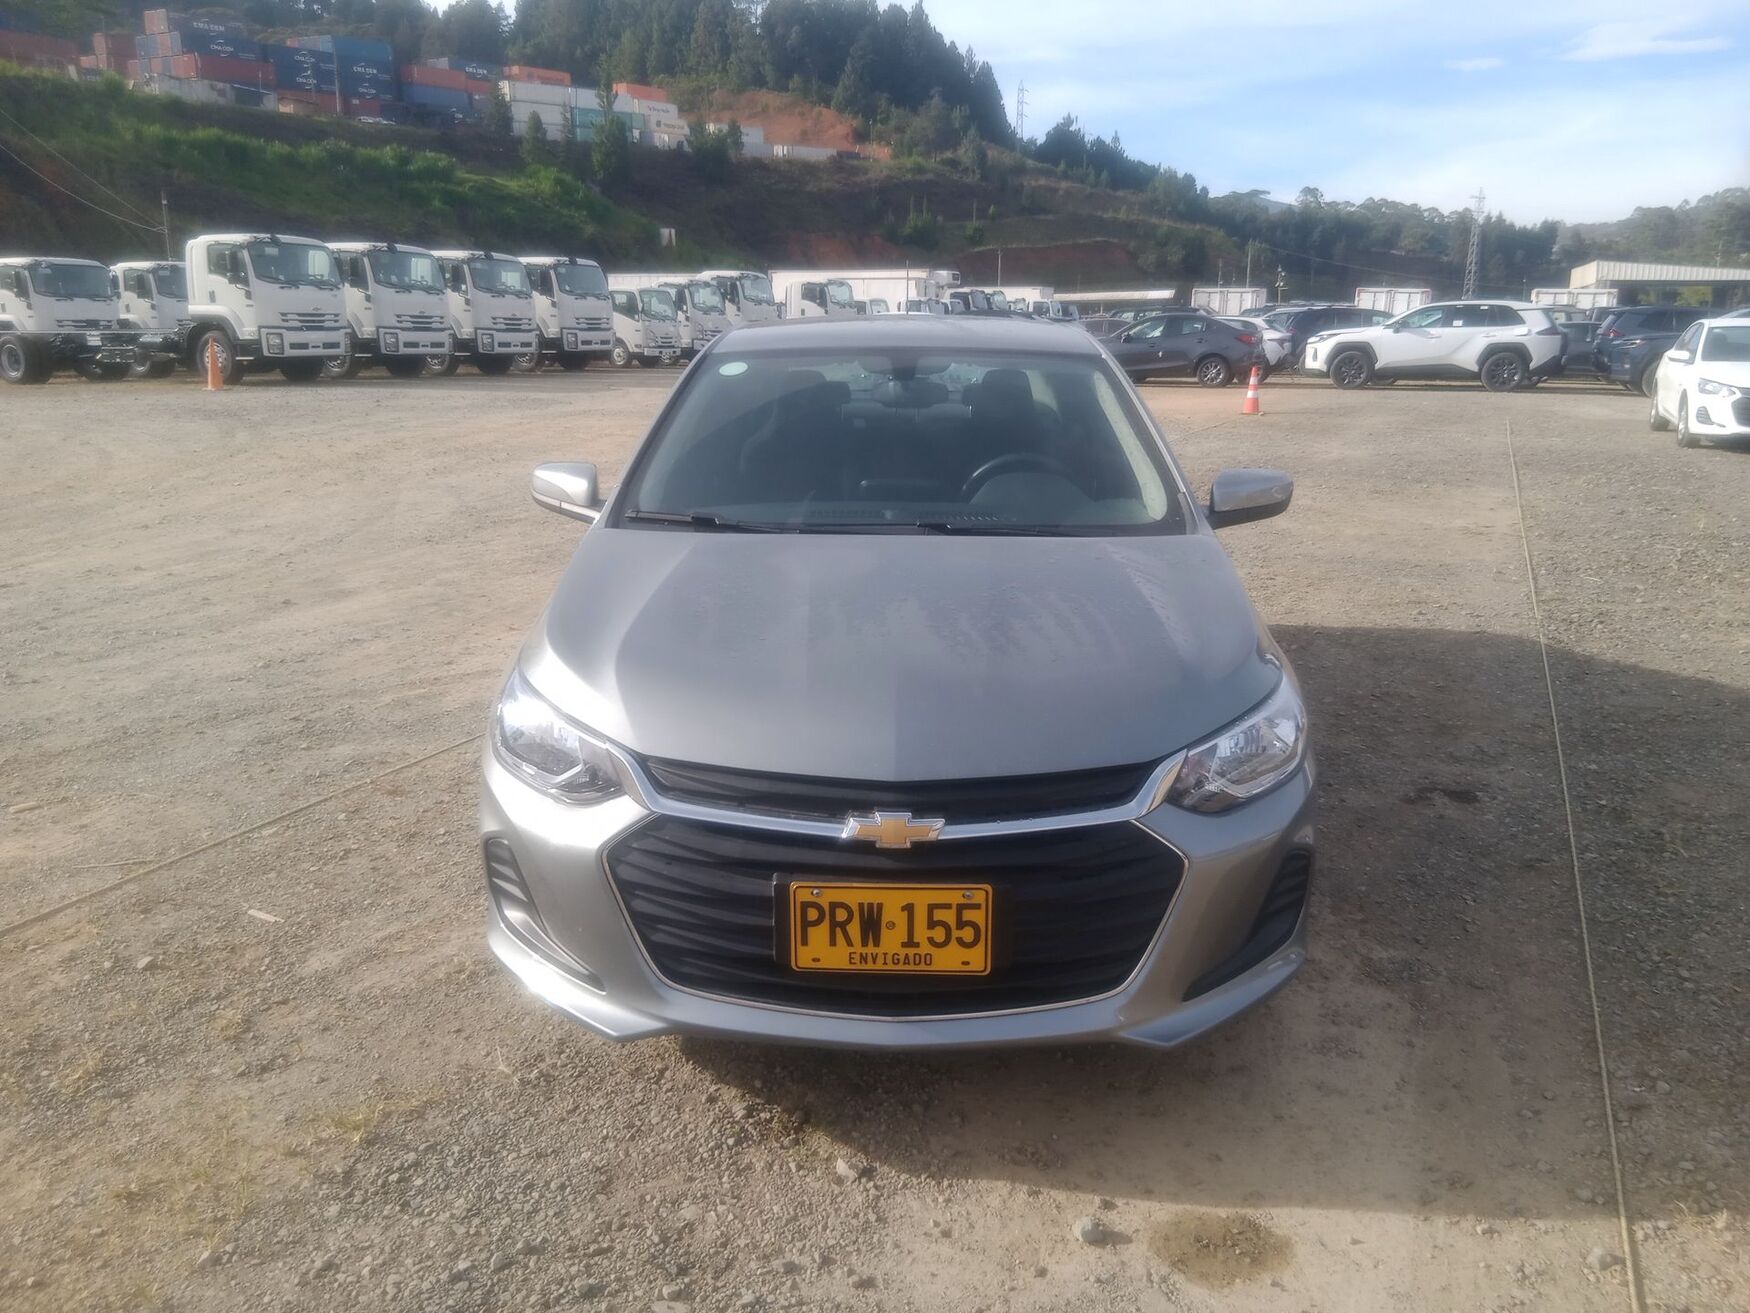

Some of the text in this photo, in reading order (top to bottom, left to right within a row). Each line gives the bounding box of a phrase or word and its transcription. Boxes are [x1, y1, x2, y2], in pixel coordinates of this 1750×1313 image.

[800, 900, 982, 950] PRW 155
[848, 951, 934, 967] ENVIGADO
